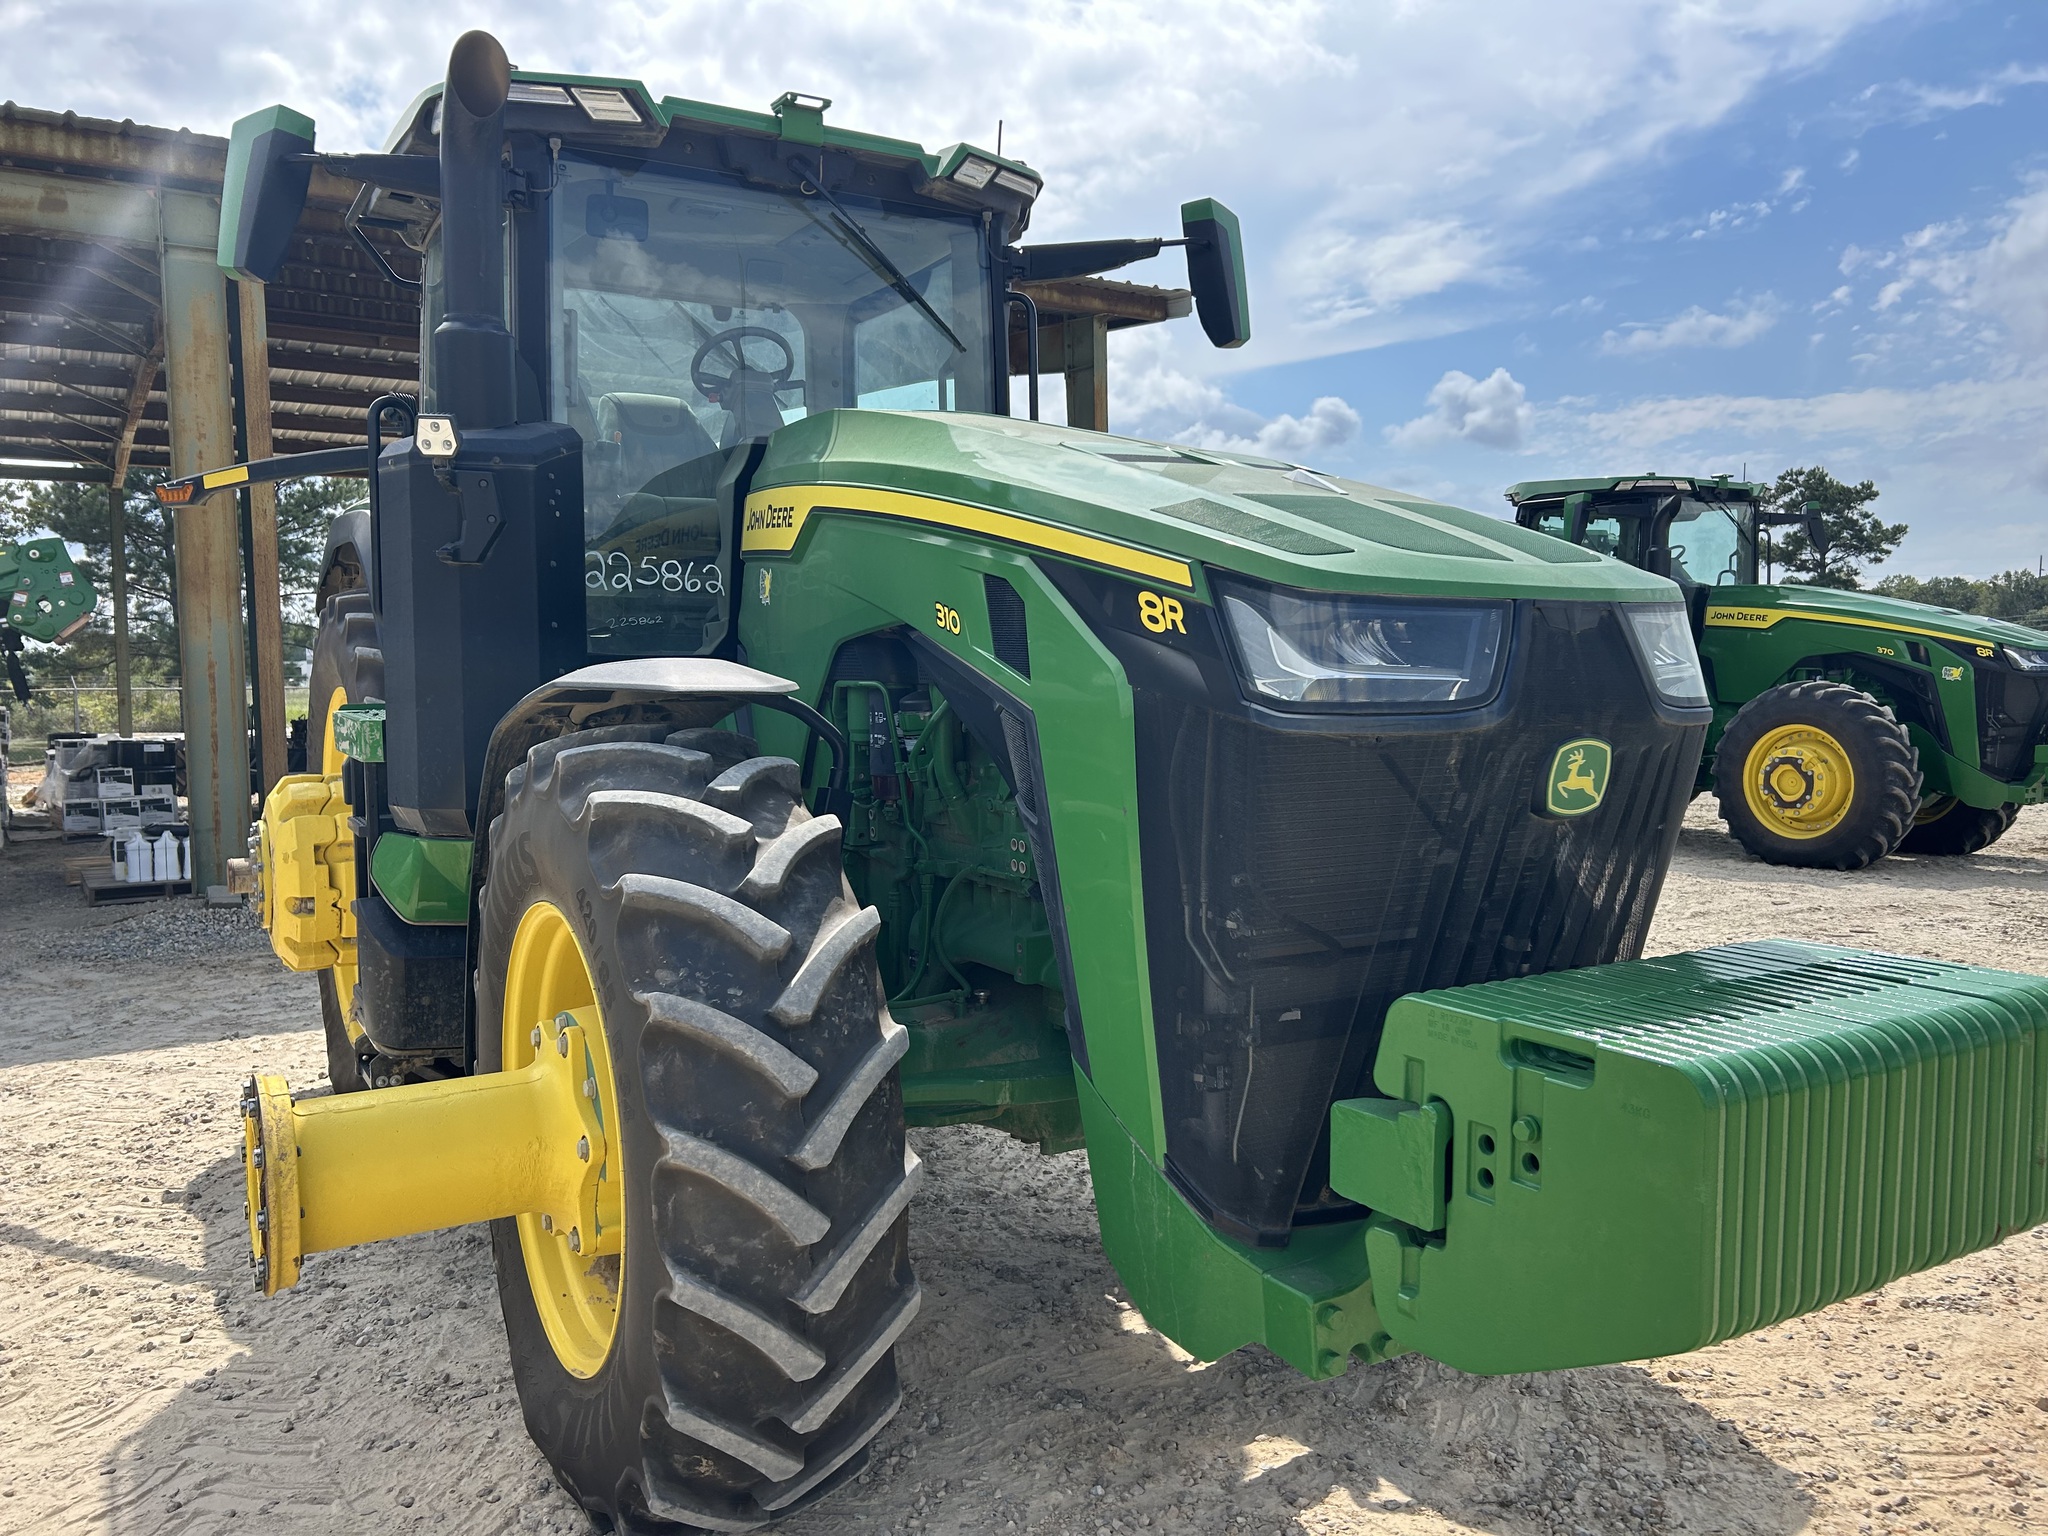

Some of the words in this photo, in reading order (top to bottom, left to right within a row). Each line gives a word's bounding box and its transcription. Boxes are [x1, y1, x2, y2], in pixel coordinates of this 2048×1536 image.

[747, 508, 766, 531] JOHN
[766, 504, 794, 529] DEERE
[584, 549, 725, 597] 225862
[605, 615, 664, 629] 225862
[935, 601, 961, 636] 310
[1137, 590, 1187, 635] 8R
[1711, 611, 1735, 620] JOHN
[1736, 612, 1768, 622] DEERE
[1876, 646, 1895, 656] 370
[1976, 647, 1995, 658] 8R
